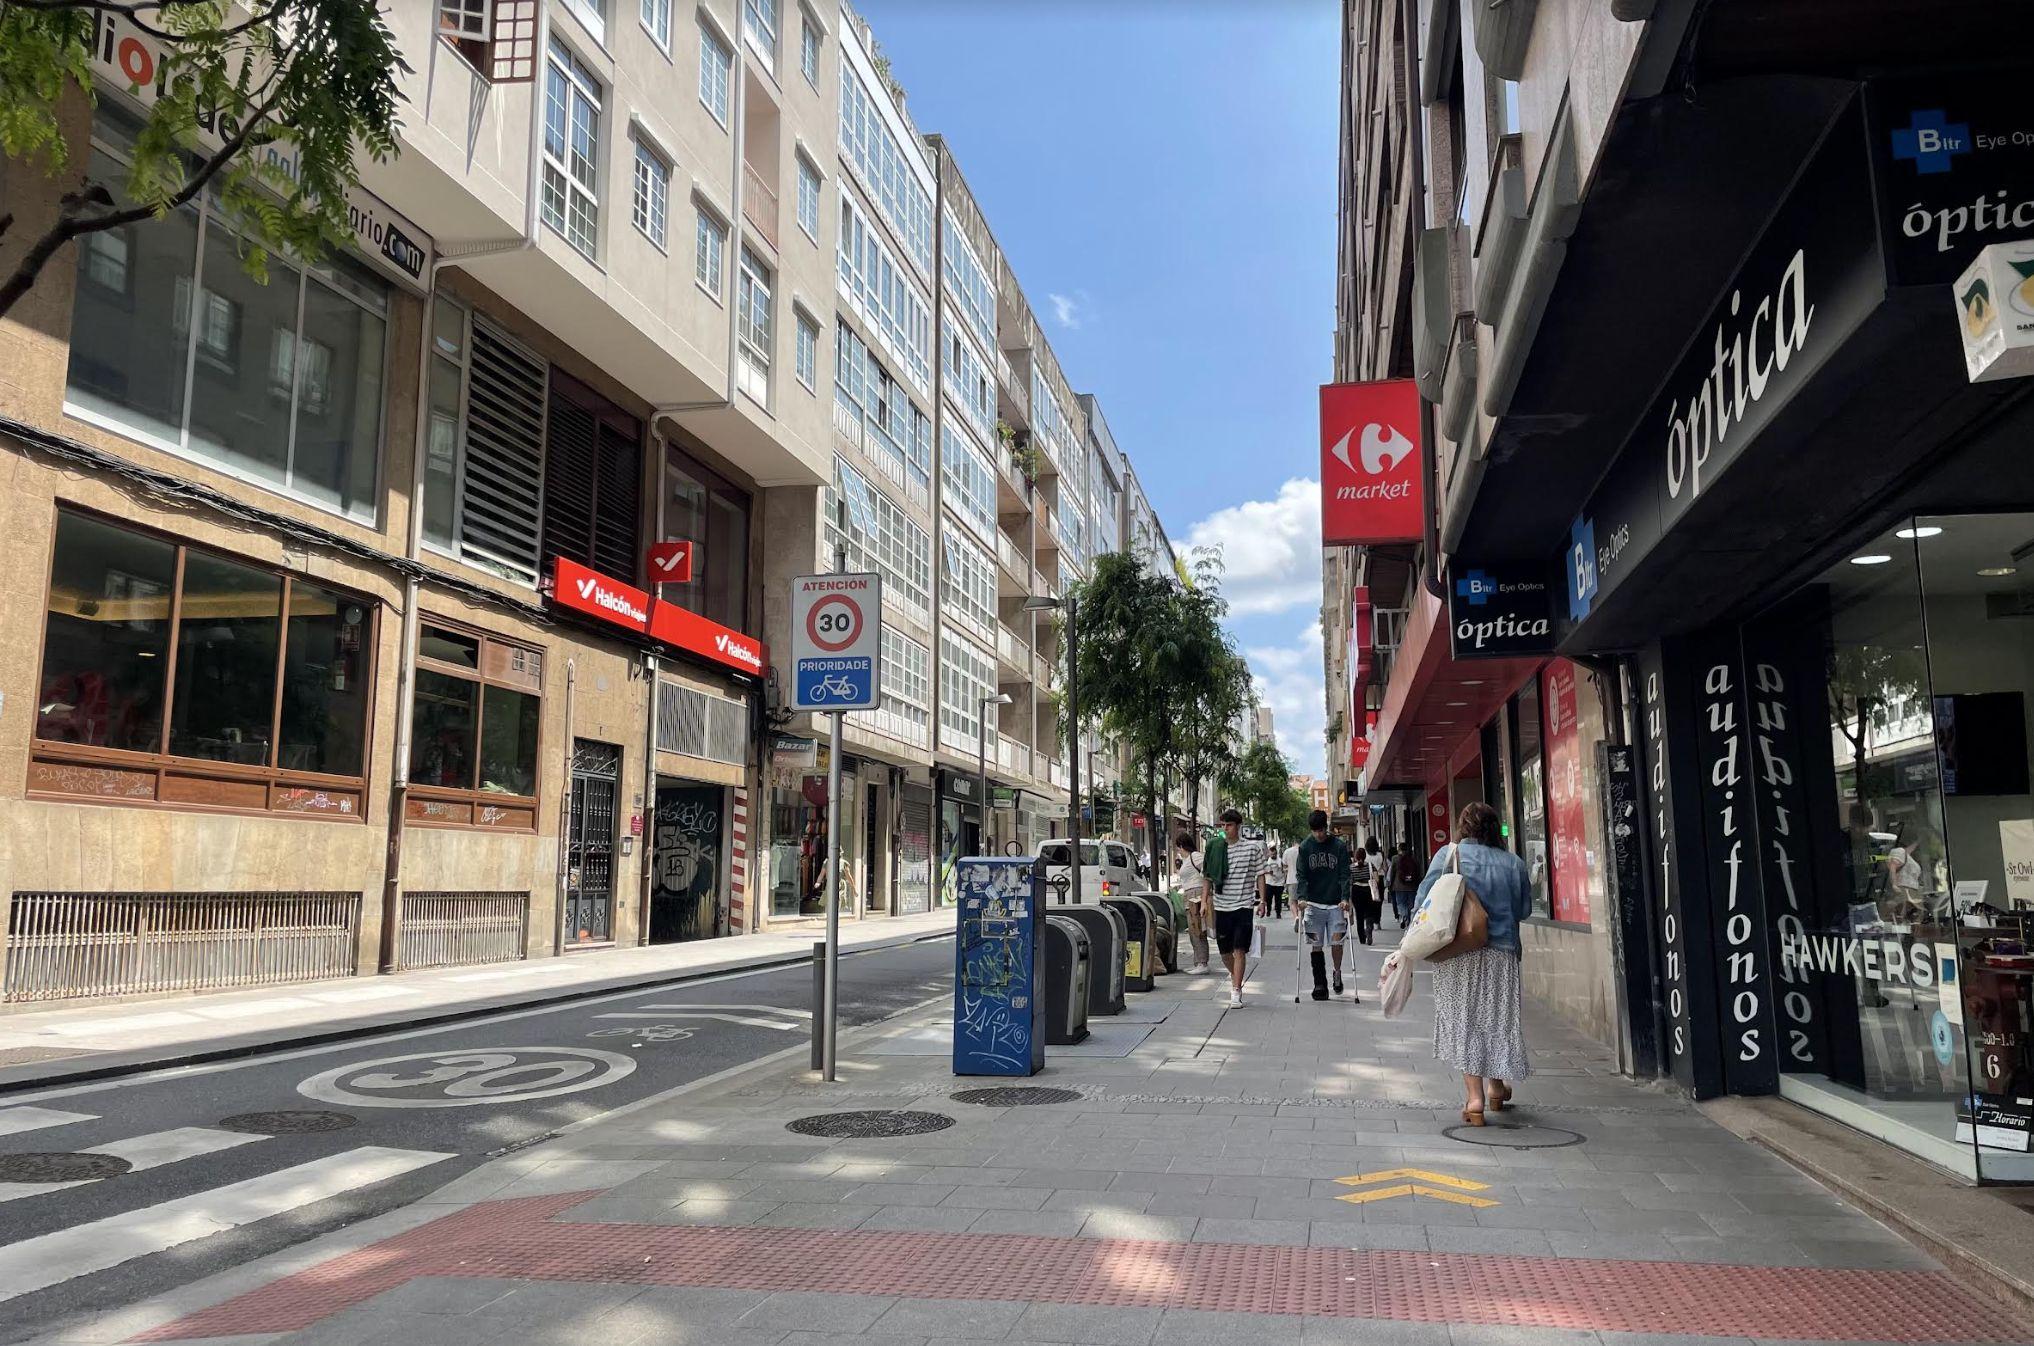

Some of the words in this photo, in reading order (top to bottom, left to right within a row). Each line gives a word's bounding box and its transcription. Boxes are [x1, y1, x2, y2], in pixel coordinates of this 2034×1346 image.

[1976, 135, 2007, 150] Eye
[1667, 248, 1815, 499] óptica
[1336, 480, 1411, 500] market
[1599, 547, 1610, 575] Eye
[1610, 523, 1629, 560] Optics
[802, 578, 867, 591] ATENCIÓN
[1500, 583, 1515, 593] Eye
[1518, 583, 1544, 592] Optics
[595, 586, 630, 616] Halcón
[820, 613, 850, 632] 30
[1457, 613, 1550, 649] óptica
[728, 640, 752, 664] Halcón
[800, 660, 869, 671] PRIORIDADE
[776, 740, 813, 750] Bazar
[1308, 852, 1337, 870] GAP
[1647, 672, 1684, 1055] audifonos
[1705, 664, 1761, 1062] audifonos
[1780, 933, 1933, 987] HAWKERS
[350, 1054, 595, 1097] 30
[1987, 1054, 2000, 1078] 6
